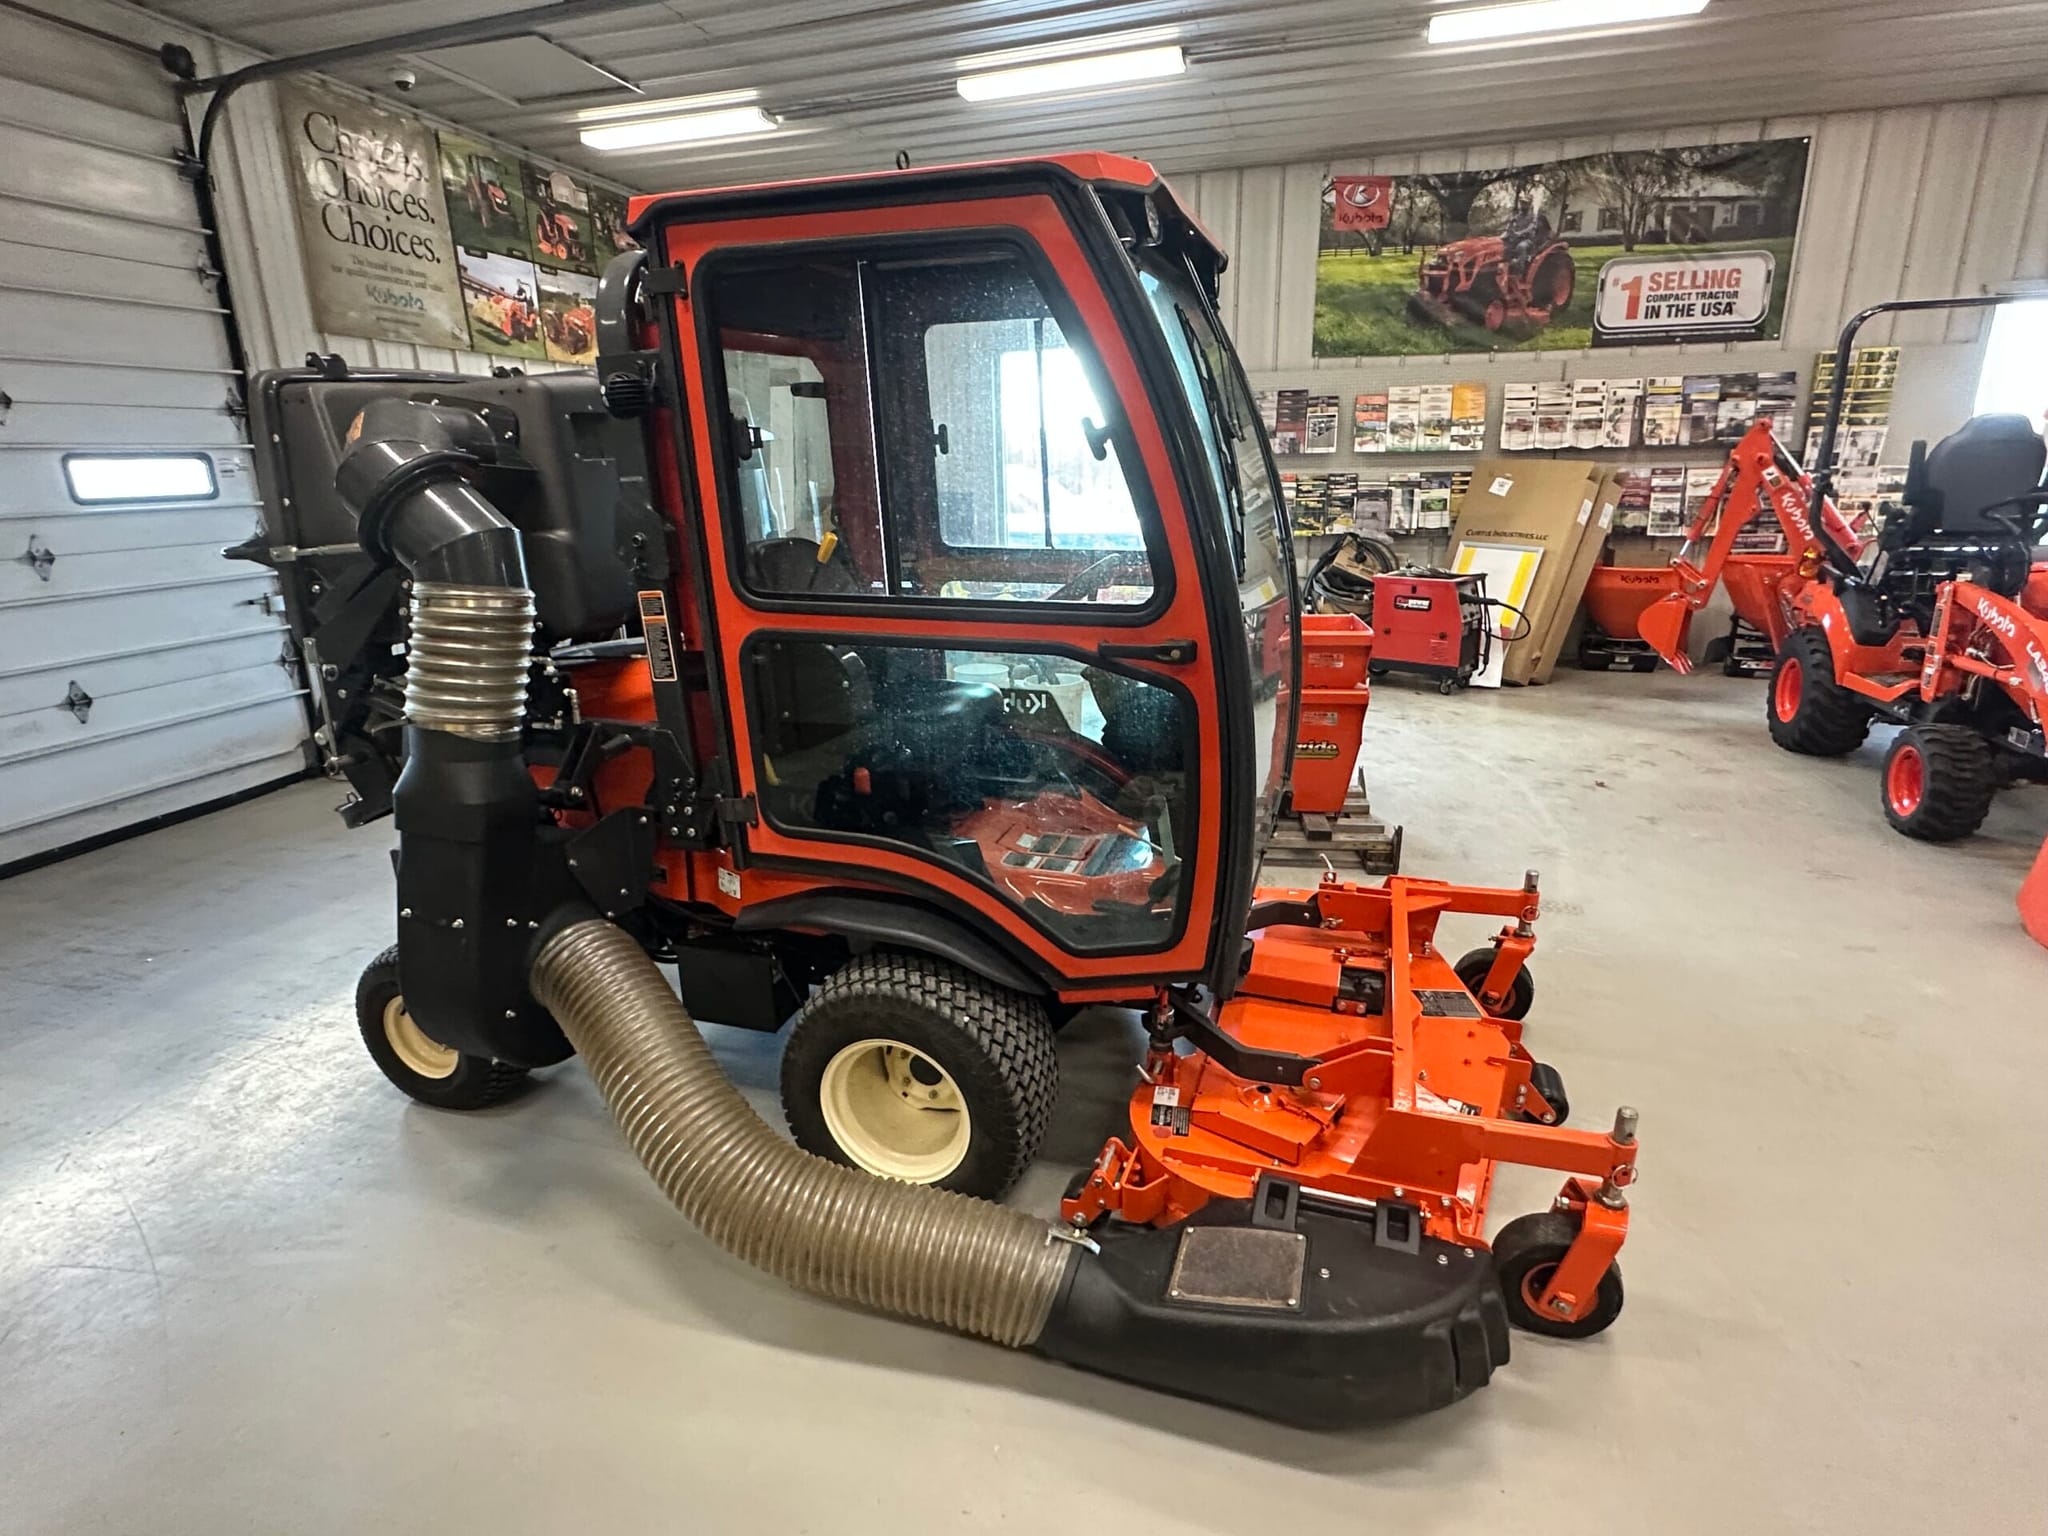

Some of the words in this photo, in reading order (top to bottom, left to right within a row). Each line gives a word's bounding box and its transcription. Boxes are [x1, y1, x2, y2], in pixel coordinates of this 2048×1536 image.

[316, 157, 435, 224] Choices.
[1338, 212, 1383, 224] Kubota
[321, 201, 441, 264] Choices.
[1648, 268, 1742, 292] SELLING
[365, 283, 426, 312] Kubota
[1646, 292, 1692, 303] COMPACT
[1695, 290, 1739, 301] TRACTOR
[1644, 304, 1661, 319] IN
[1666, 303, 1695, 318] THE
[1781, 493, 1815, 541] Kubota
[1619, 575, 1660, 584] Kubota
[1976, 597, 2016, 637] Kubota
